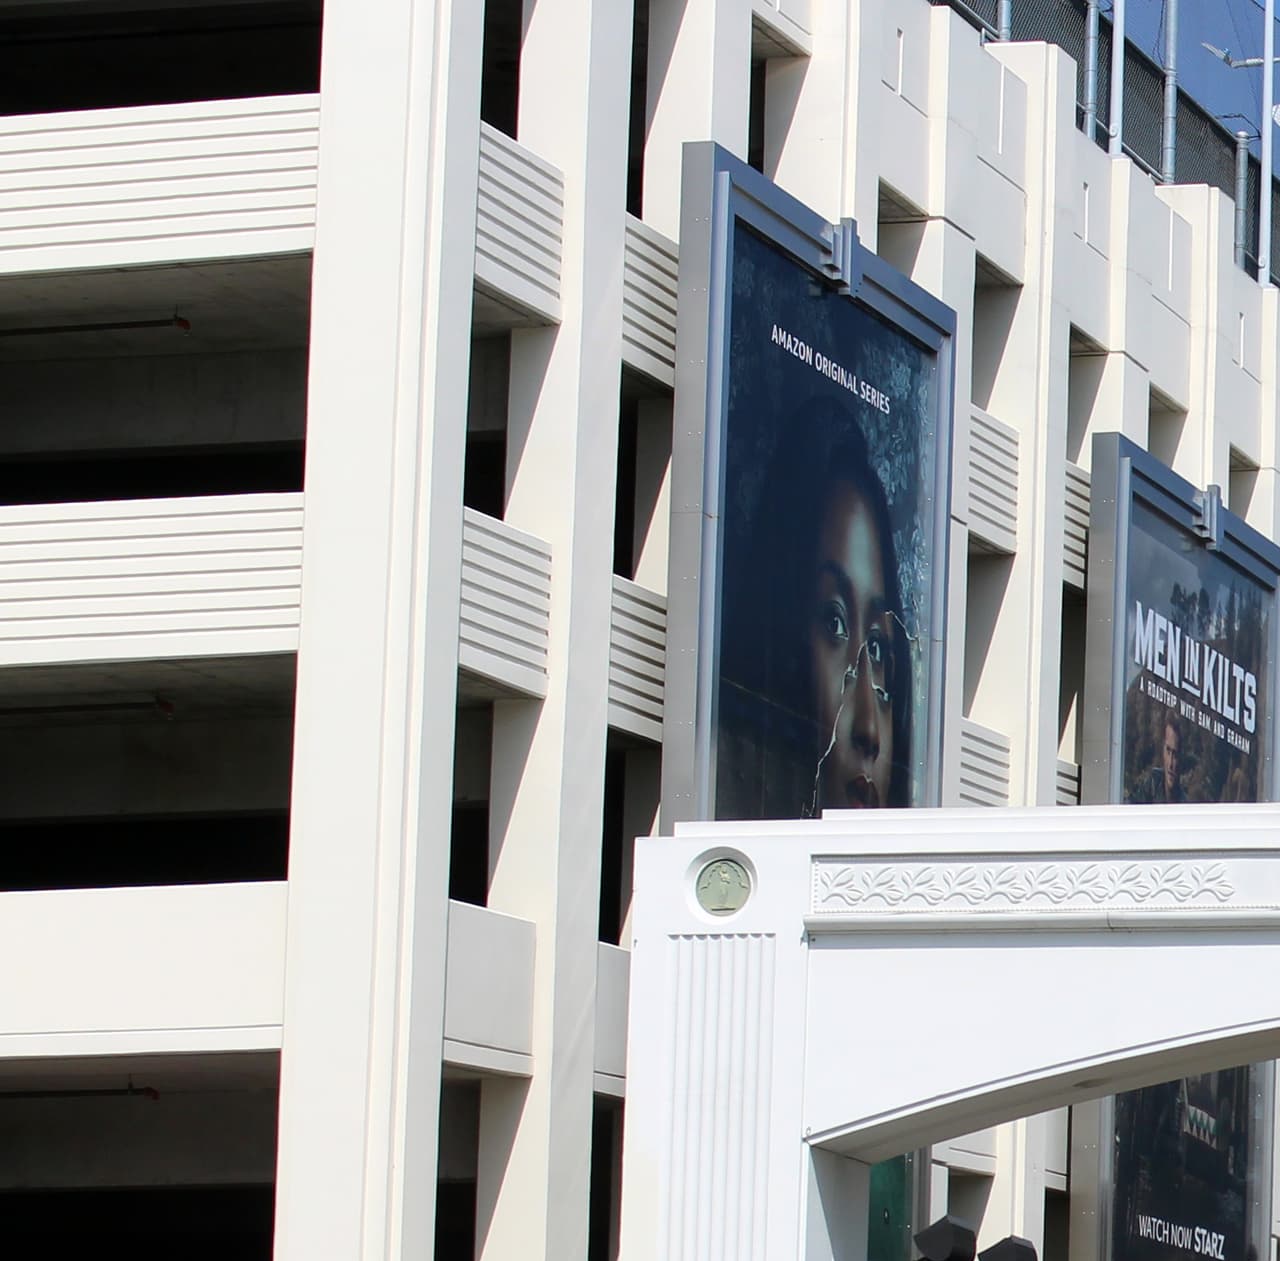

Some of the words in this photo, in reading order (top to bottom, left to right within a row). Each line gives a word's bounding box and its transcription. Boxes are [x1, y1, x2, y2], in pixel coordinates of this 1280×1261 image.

[771, 324, 813, 366] AMAZON
[815, 352, 858, 395] ORIGINAL
[860, 381, 890, 414] SERIES
[1134, 600, 1181, 688] MEN
[1184, 635, 1200, 688] IN
[1202, 644, 1257, 734] KILTS
[1139, 676, 1144, 692] A
[1147, 680, 1177, 708] ROADTRIP
[1180, 700, 1196, 723] WITH
[1198, 711, 1211, 732] SAM
[1213, 720, 1225, 740] AND
[1227, 728, 1250, 755] GRAHAM
[1138, 1214, 1169, 1244] WATCH
[1171, 1223, 1192, 1250] NOW
[1194, 1226, 1225, 1261] STARZ
